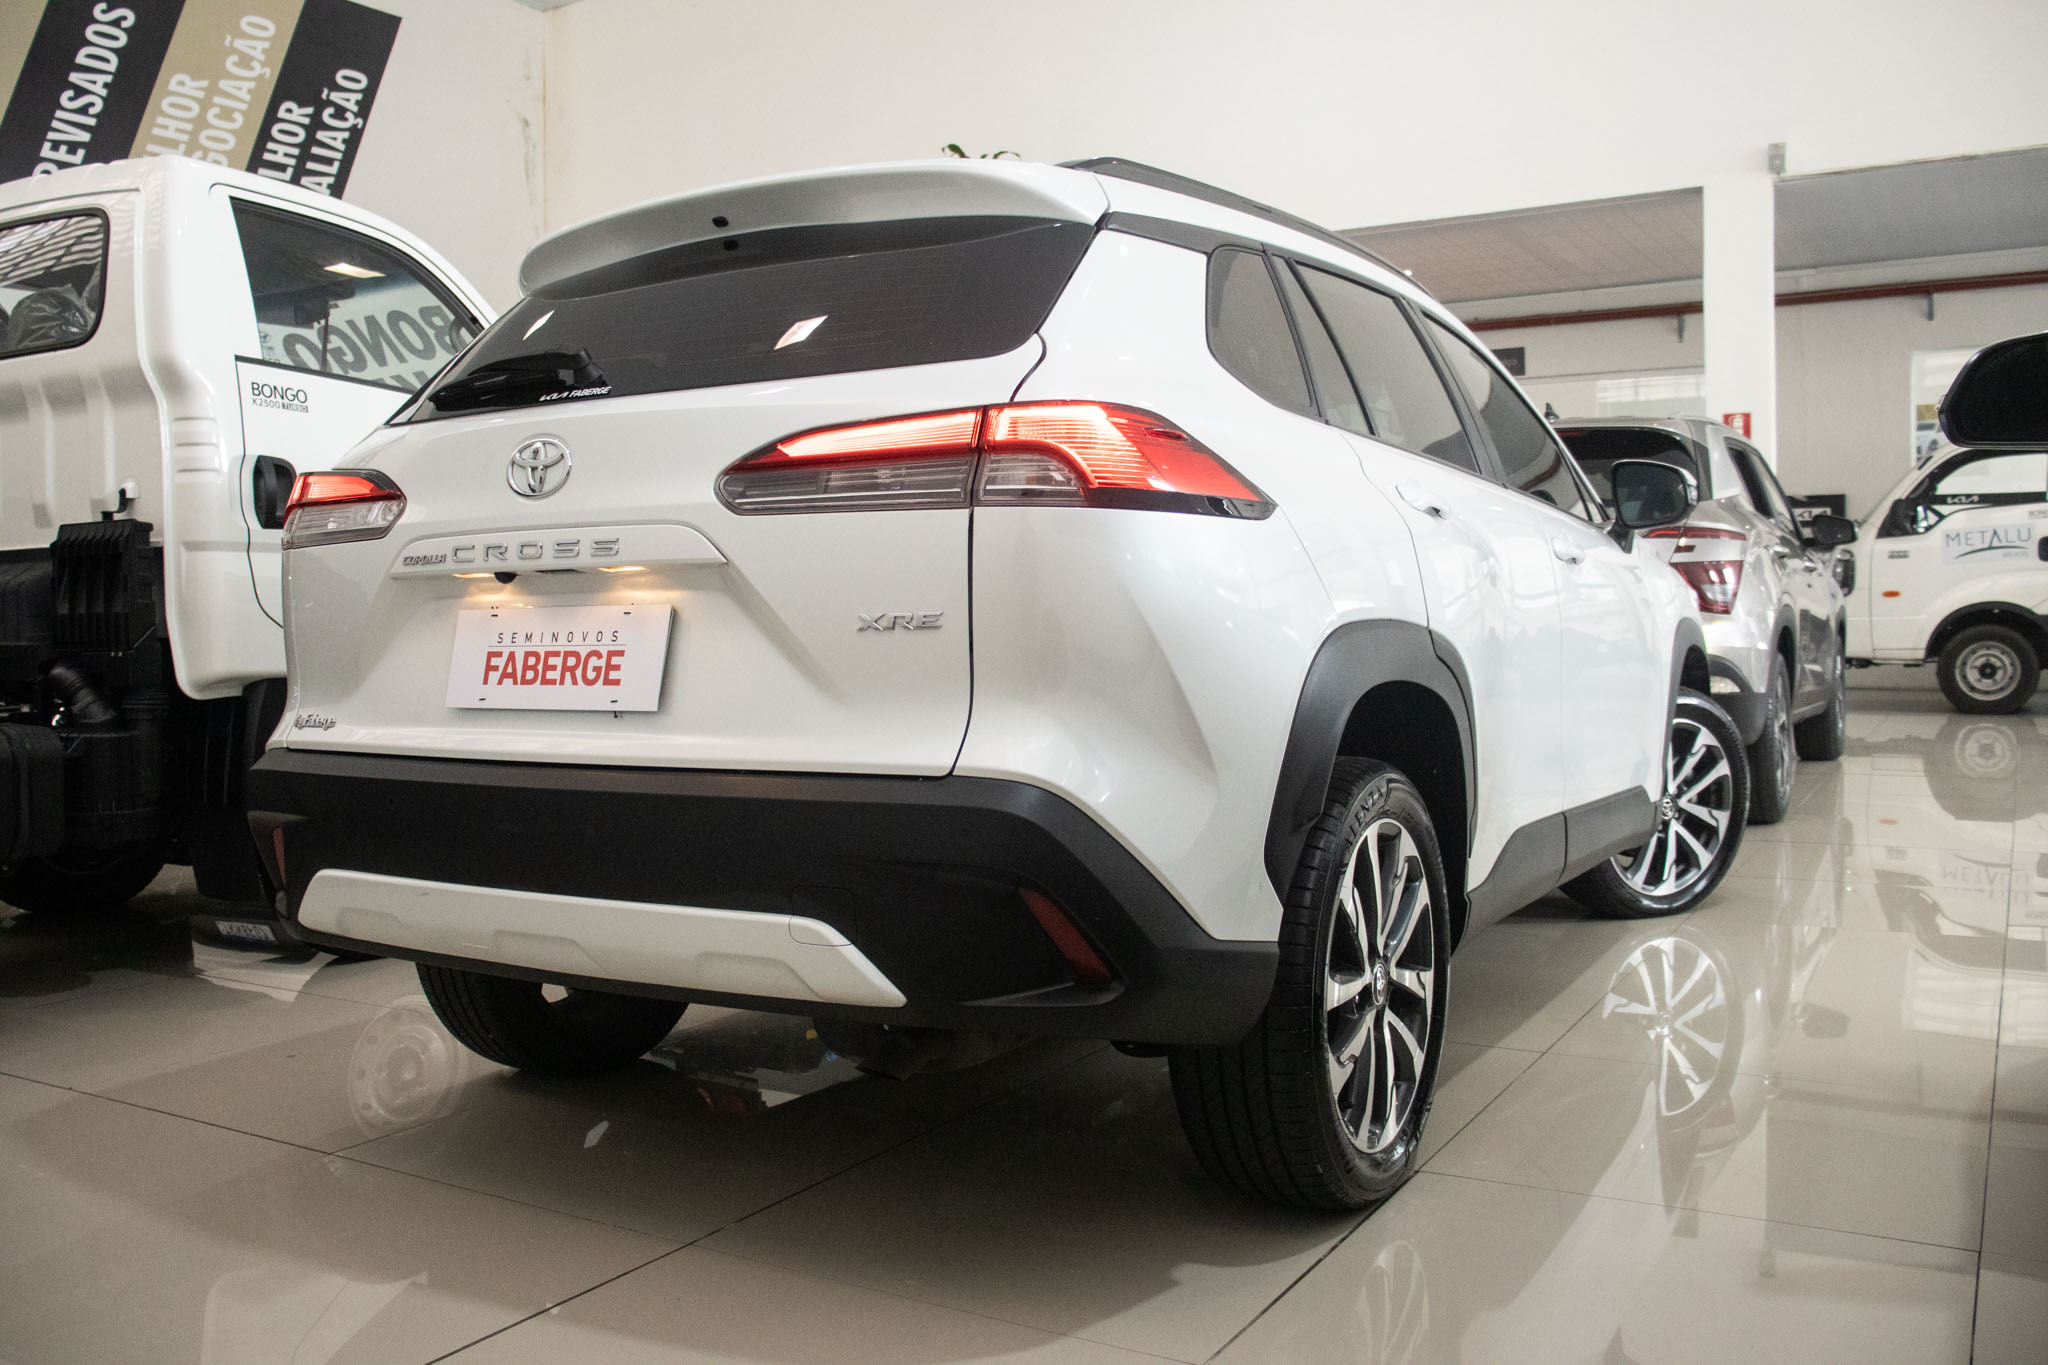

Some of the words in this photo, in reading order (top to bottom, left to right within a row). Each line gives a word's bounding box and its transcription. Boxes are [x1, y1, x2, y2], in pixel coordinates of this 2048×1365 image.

[192, 15, 276, 167] GOCIAÇÃO
[145, 73, 209, 158] LHOR
[257, 101, 314, 181] LHOR
[300, 69, 368, 196] ALIAÇÃO
[251, 381, 308, 404] BONGO
[252, 397, 281, 409] K2500
[569, 386, 612, 398] FABERGE
[1945, 528, 2032, 549] METALU
[402, 553, 447, 567] COROLLA
[451, 537, 620, 563] CROSS
[856, 611, 944, 632] XRE
[496, 630, 619, 644] SEMINOVOS
[482, 649, 626, 687] FABERGE
